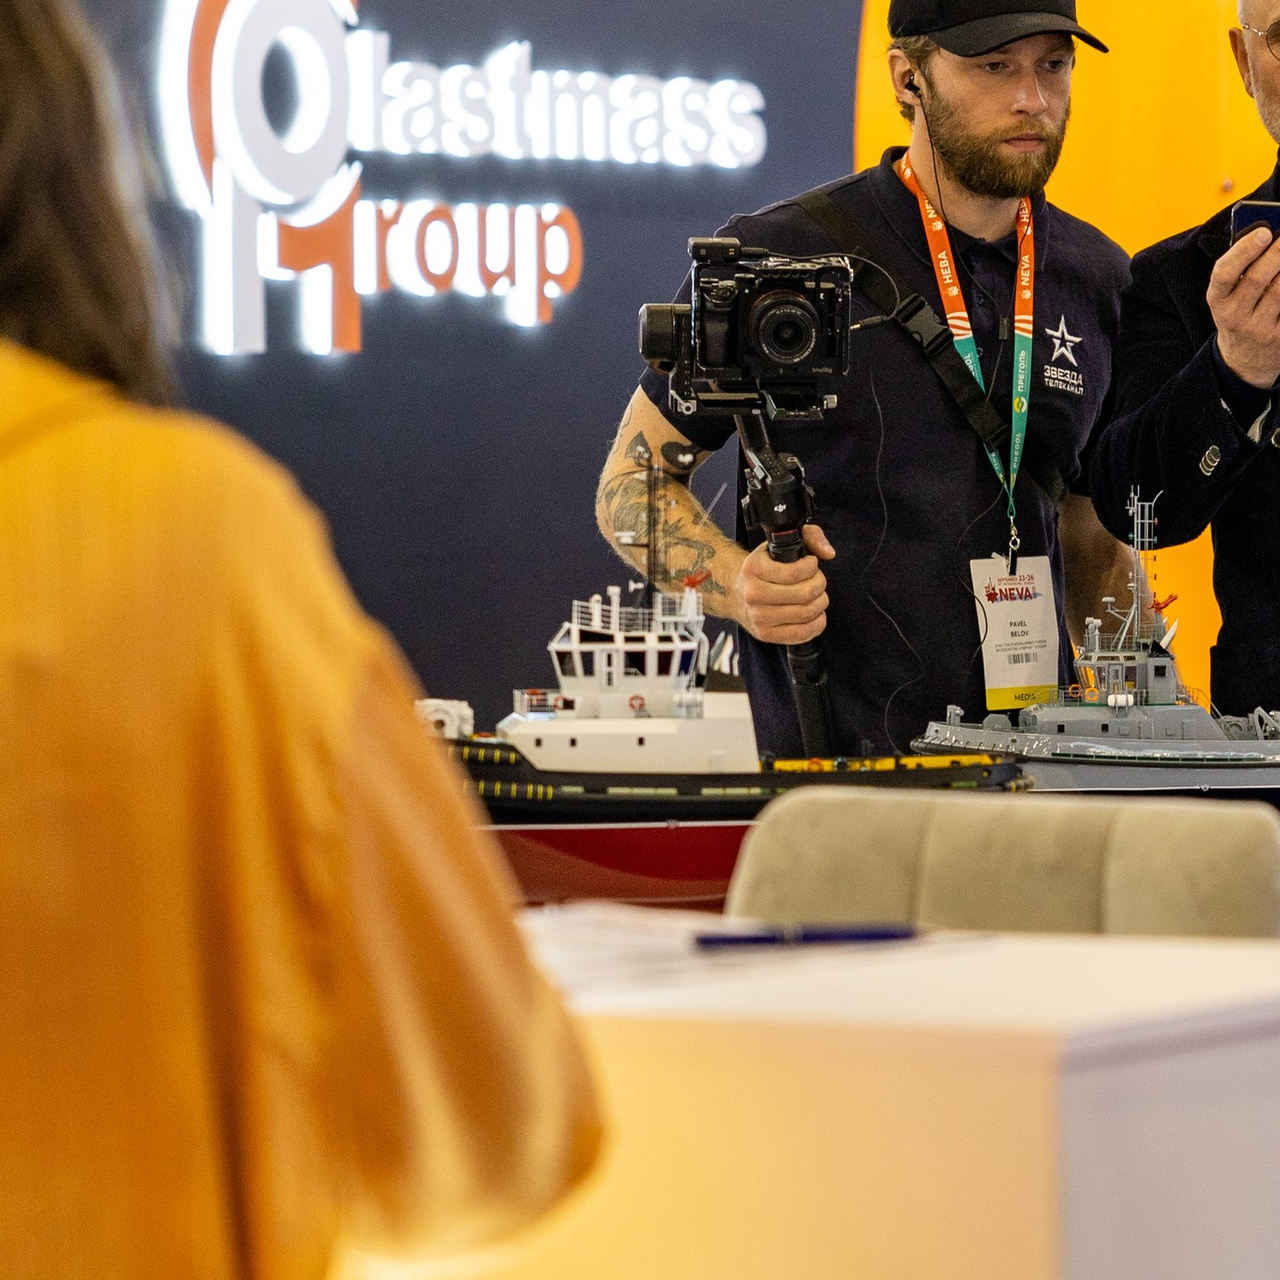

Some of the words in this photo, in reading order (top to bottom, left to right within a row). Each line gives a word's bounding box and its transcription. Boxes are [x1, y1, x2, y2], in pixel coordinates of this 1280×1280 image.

[1021, 254, 1030, 286] NEVA
[1017, 349, 1026, 392] ПРЕГОЛЬ
[1043, 364, 1083, 387] ЗВЕЗДА
[1043, 377, 1084, 396] ТЕЛЕКАНАЛ
[1012, 431, 1022, 469] PREGOL
[998, 586, 1033, 601] NEVA
[1009, 620, 1028, 628] PAVEL
[1010, 630, 1030, 638] BELOV
[1014, 693, 1036, 701] MEDIA
